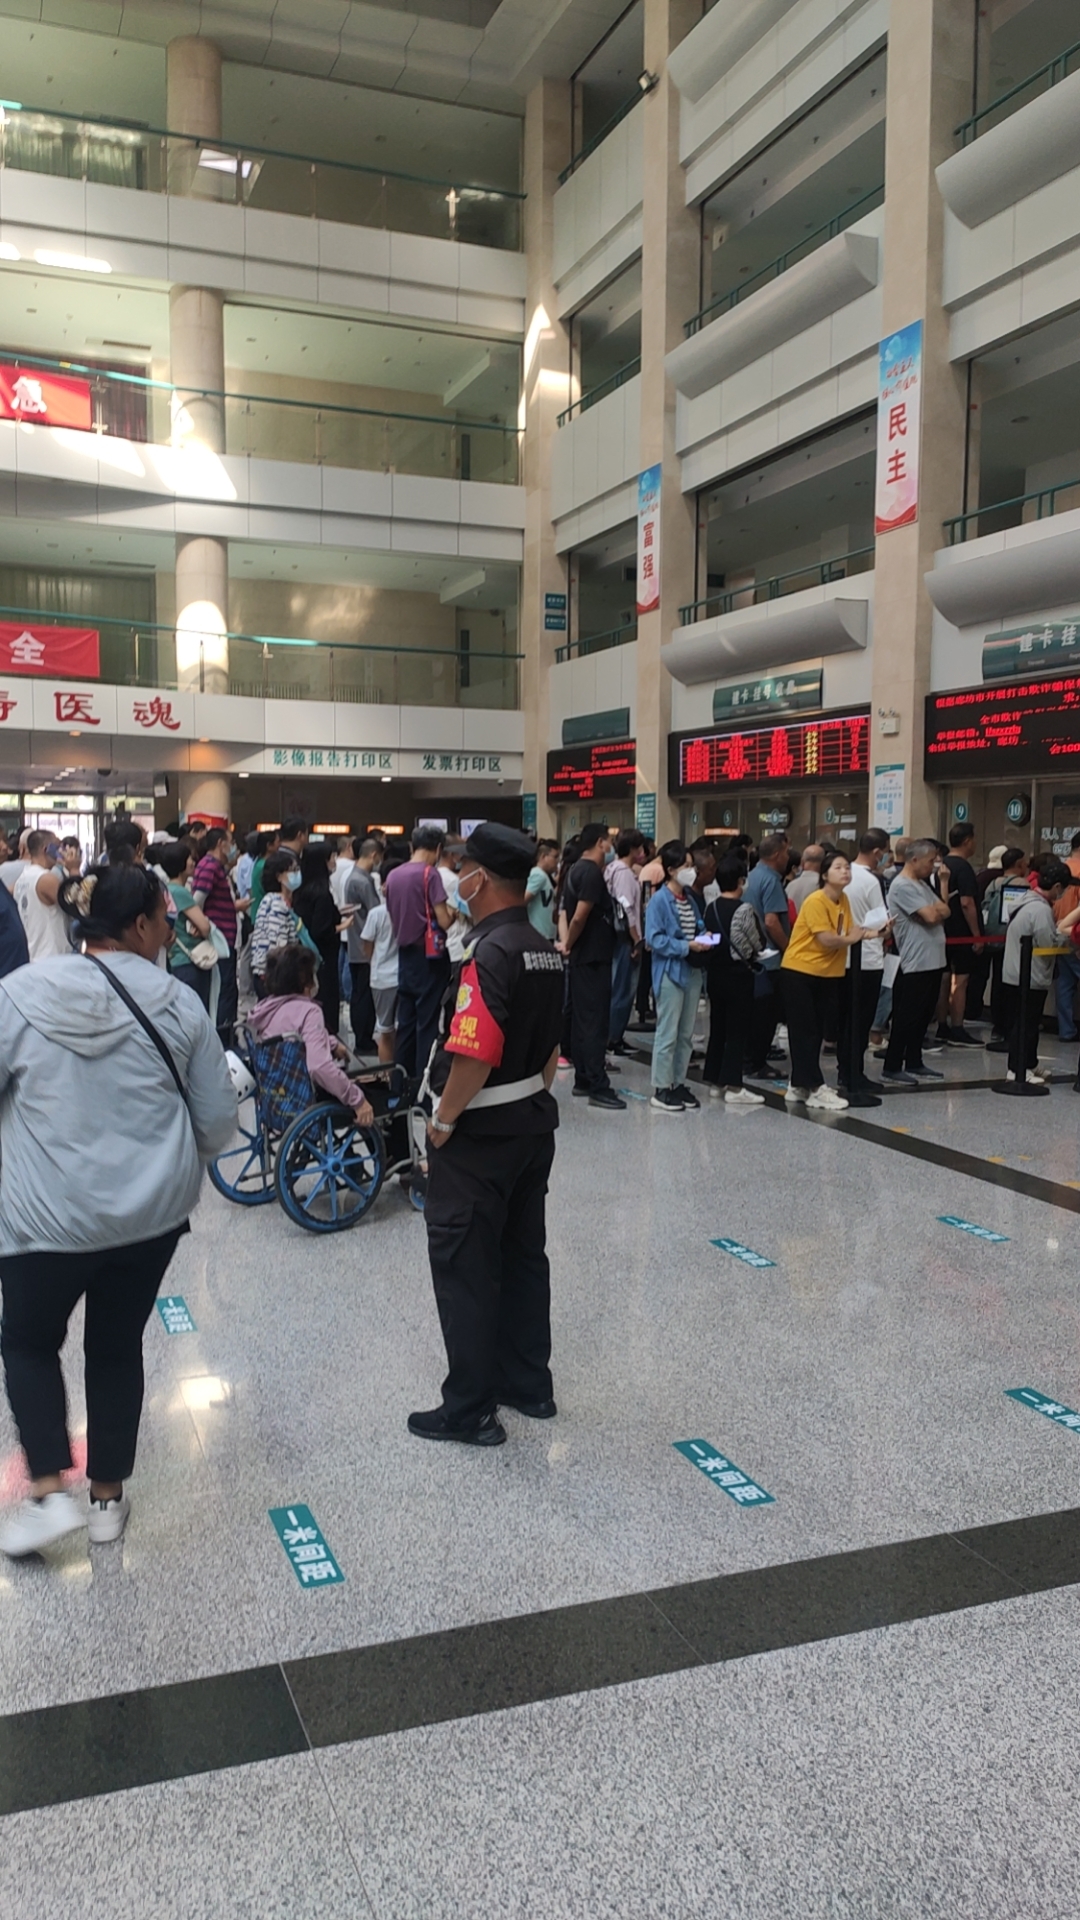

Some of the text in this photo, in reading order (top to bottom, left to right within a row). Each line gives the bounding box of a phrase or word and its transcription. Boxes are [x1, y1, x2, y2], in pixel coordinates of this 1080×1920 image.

[886, 402, 907, 485] 民主
[643, 521, 655, 580] 富强
[9, 630, 46, 666] 全
[273, 749, 393, 769] 影像报告打印区
[422, 753, 502, 772] 发票打印区
[1010, 804, 1020, 816] 10
[1021, 1391, 1080, 1432] 一米间
[690, 1443, 767, 1502] 一米间距
[283, 1509, 337, 1583] 一米间距
